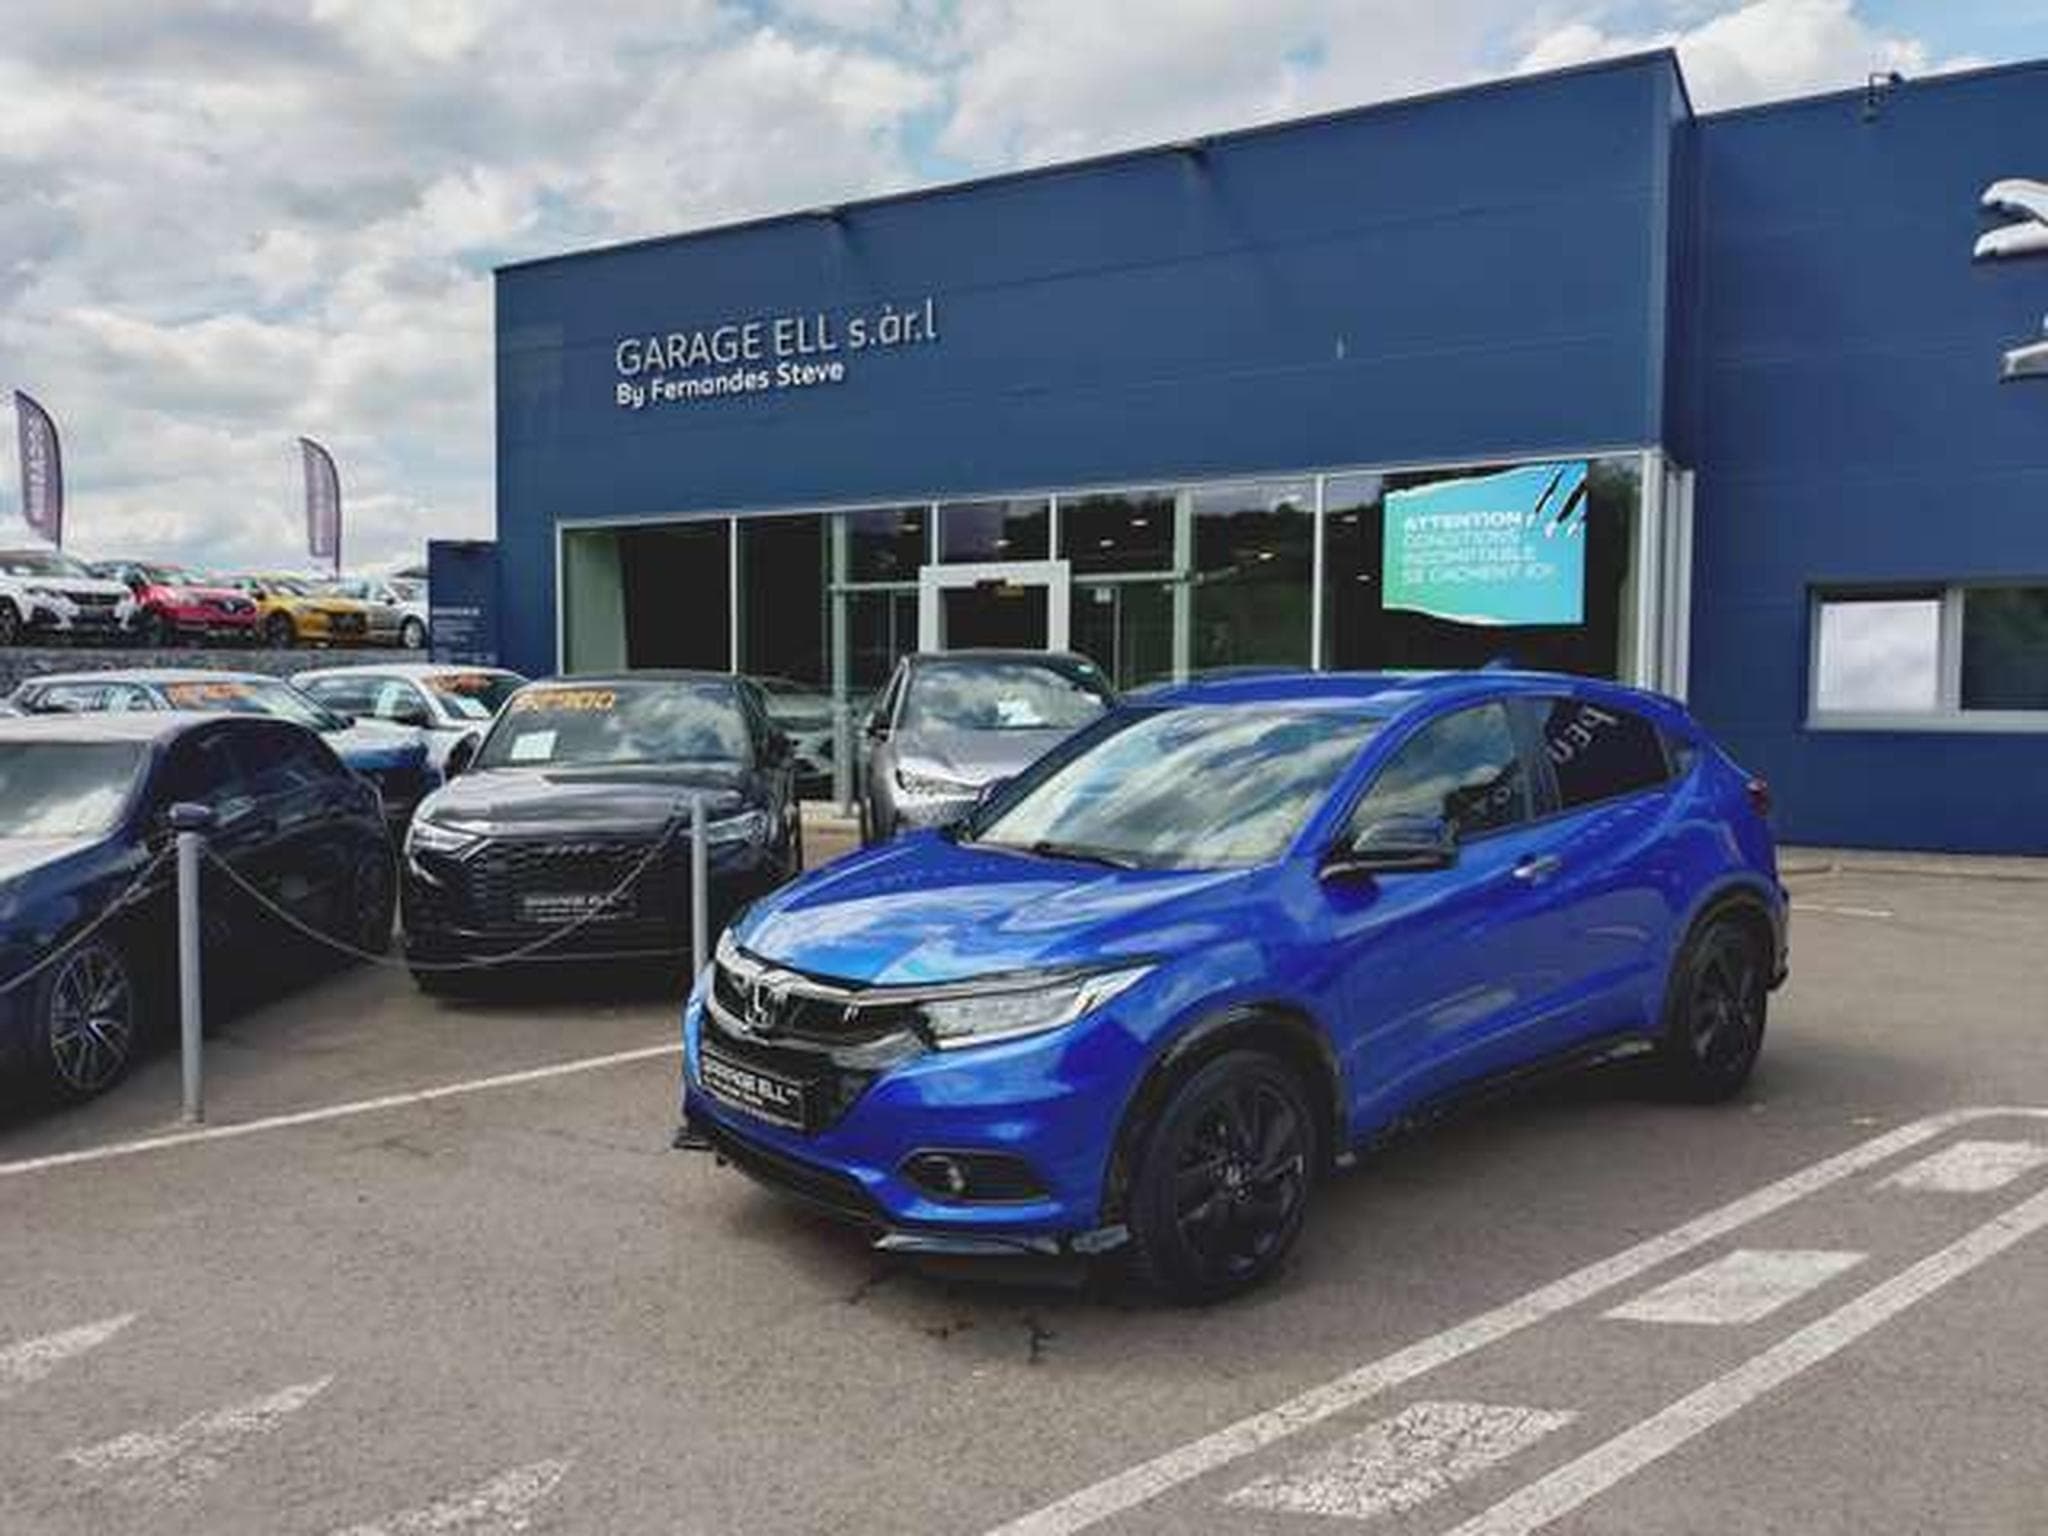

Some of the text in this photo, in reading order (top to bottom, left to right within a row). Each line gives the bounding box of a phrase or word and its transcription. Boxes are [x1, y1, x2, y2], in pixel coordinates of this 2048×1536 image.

[615, 322, 762, 376] GARAGE
[774, 314, 837, 357] ELL
[616, 362, 845, 408] By Fernandes Steve
